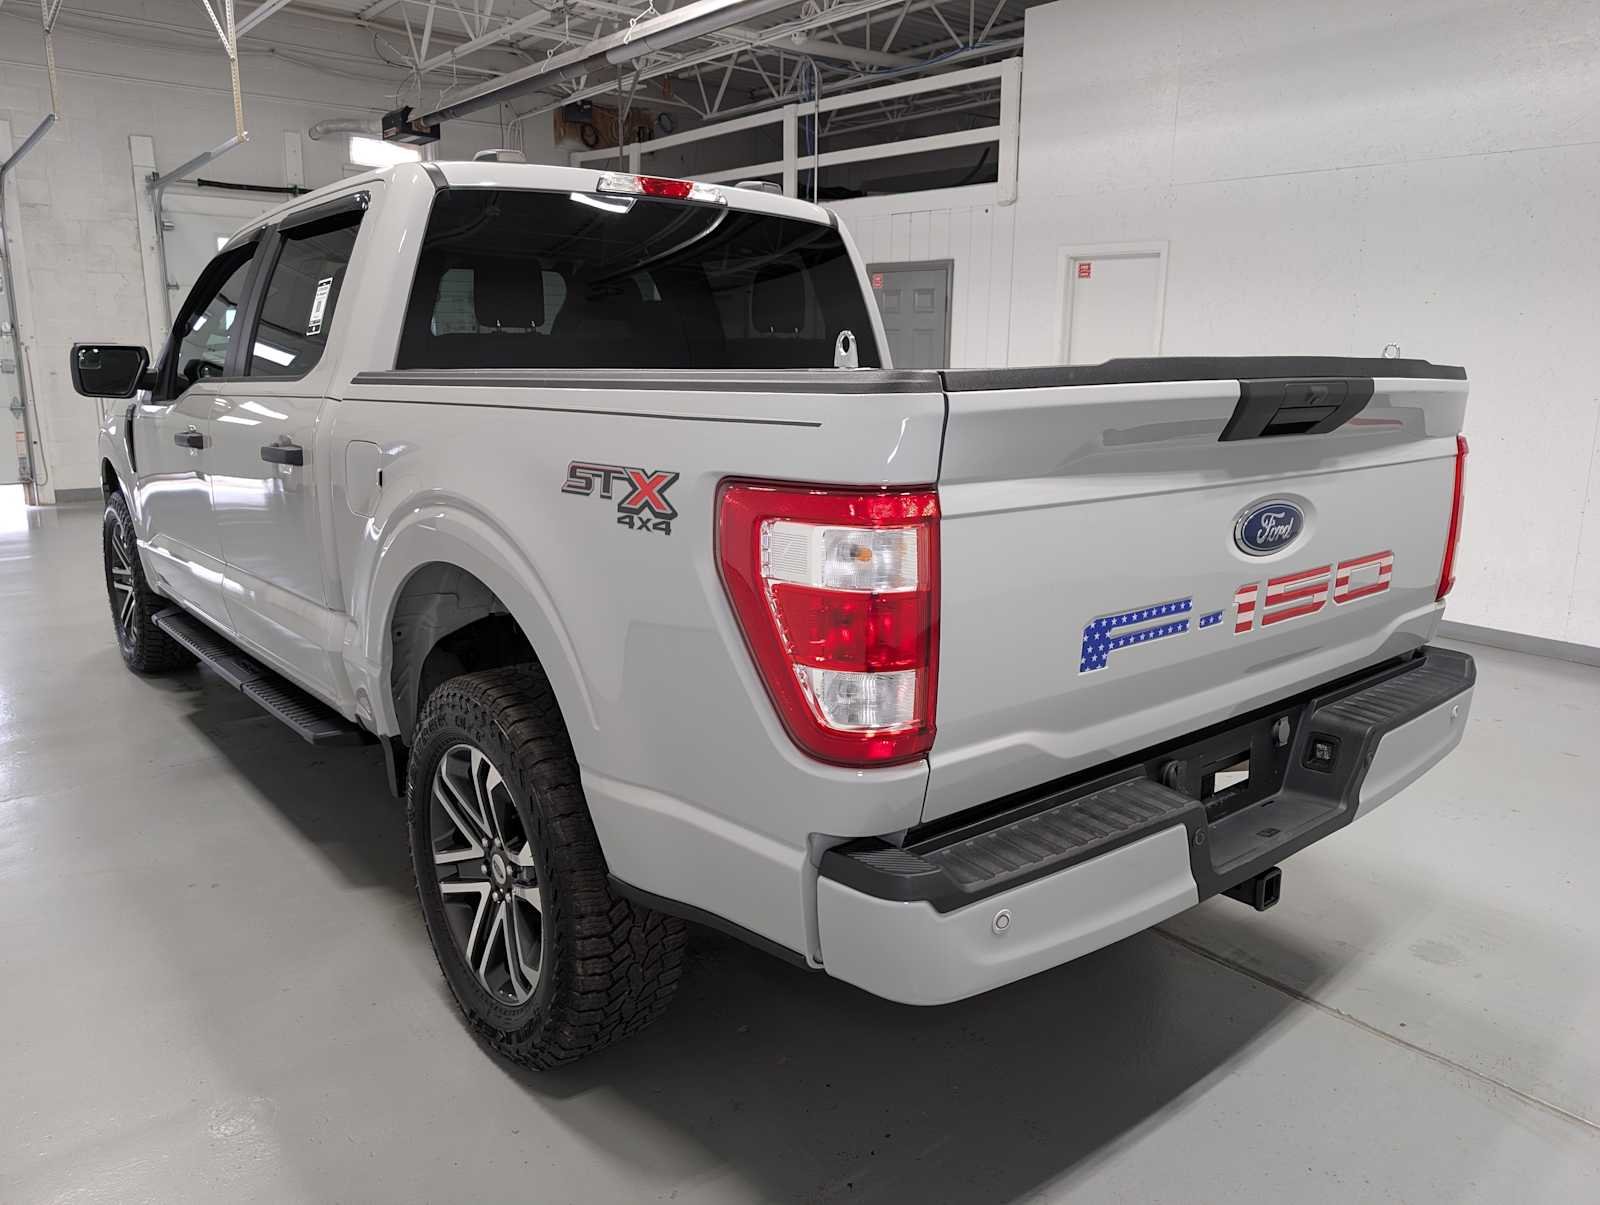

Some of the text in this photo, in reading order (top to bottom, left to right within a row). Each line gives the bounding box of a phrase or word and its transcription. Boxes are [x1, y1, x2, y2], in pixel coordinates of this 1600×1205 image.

[561, 460, 680, 520] STX
[1257, 512, 1294, 544] Ford
[1079, 549, 1394, 675] F-150
